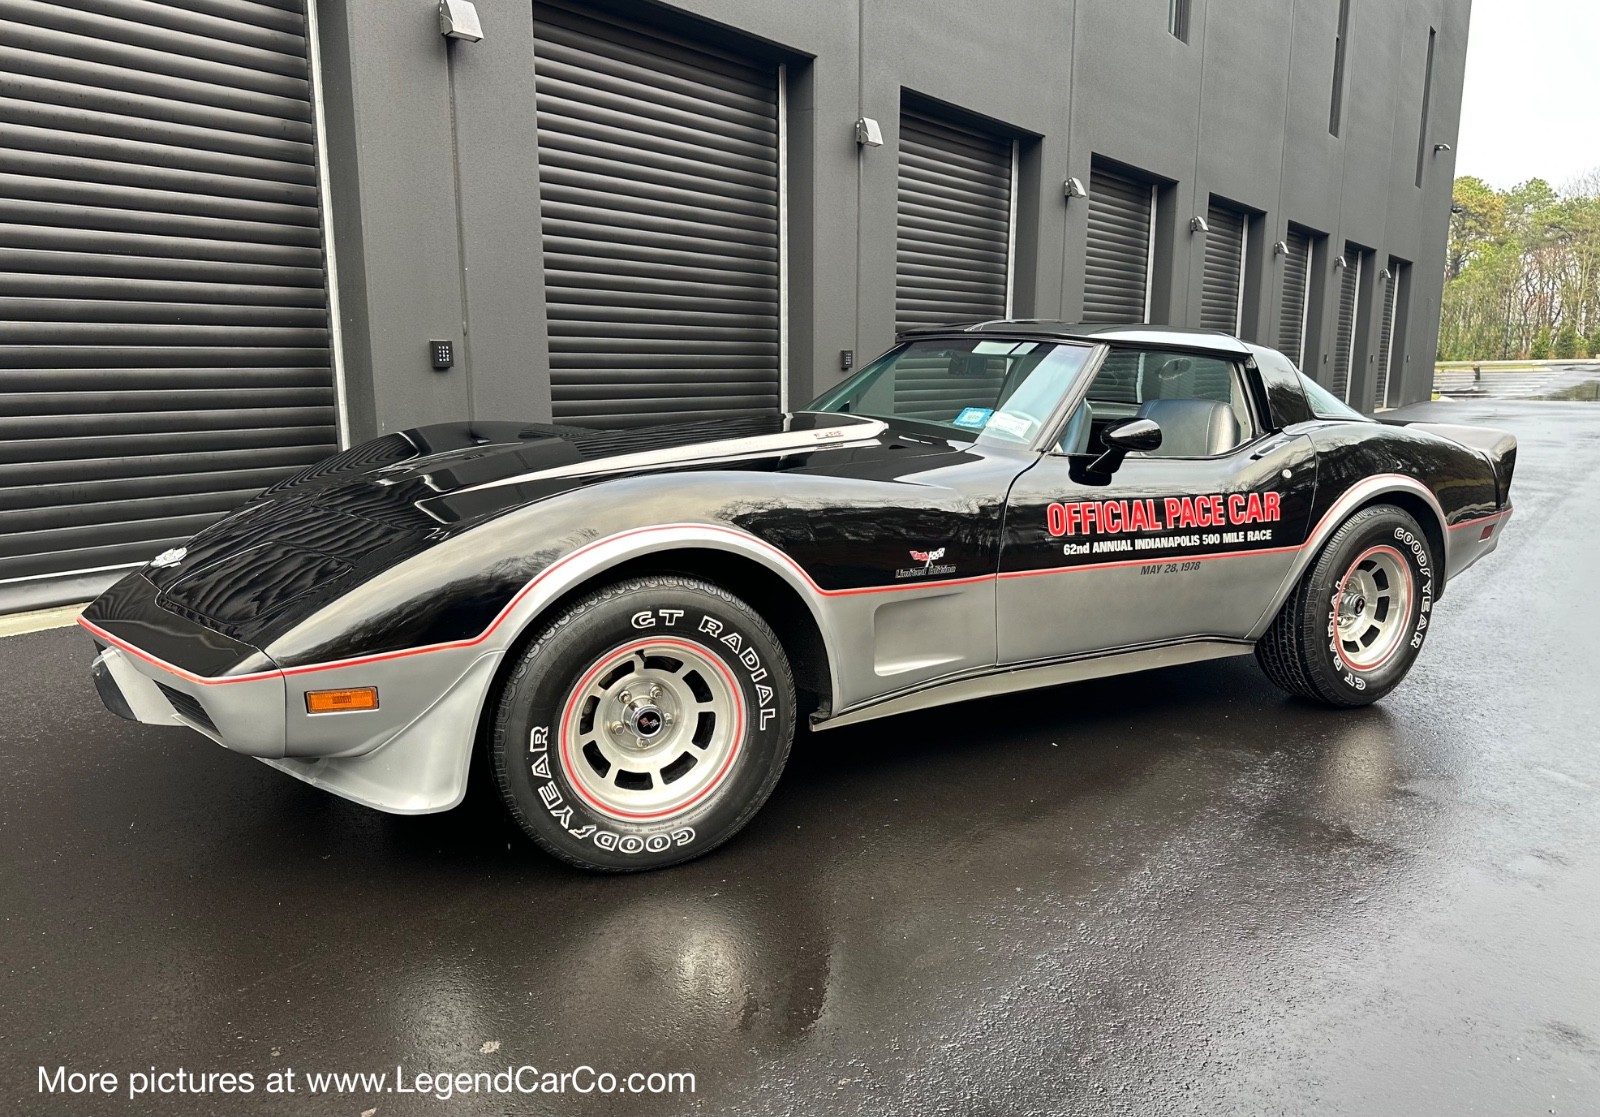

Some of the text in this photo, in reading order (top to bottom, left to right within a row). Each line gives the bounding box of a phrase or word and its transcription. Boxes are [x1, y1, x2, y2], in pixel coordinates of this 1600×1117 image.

[1047, 491, 1280, 537] OFFICIAL PACE CAR
[1063, 529, 1272, 555] 62nd ANNUAL INDIANAPOLIS 500 MILE RACE
[1140, 561, 1201, 575] MAY 28, 1978
[631, 609, 776, 731] GT RADIAL
[1344, 672, 1366, 690] GT
[529, 725, 696, 854] GOODYEAR
